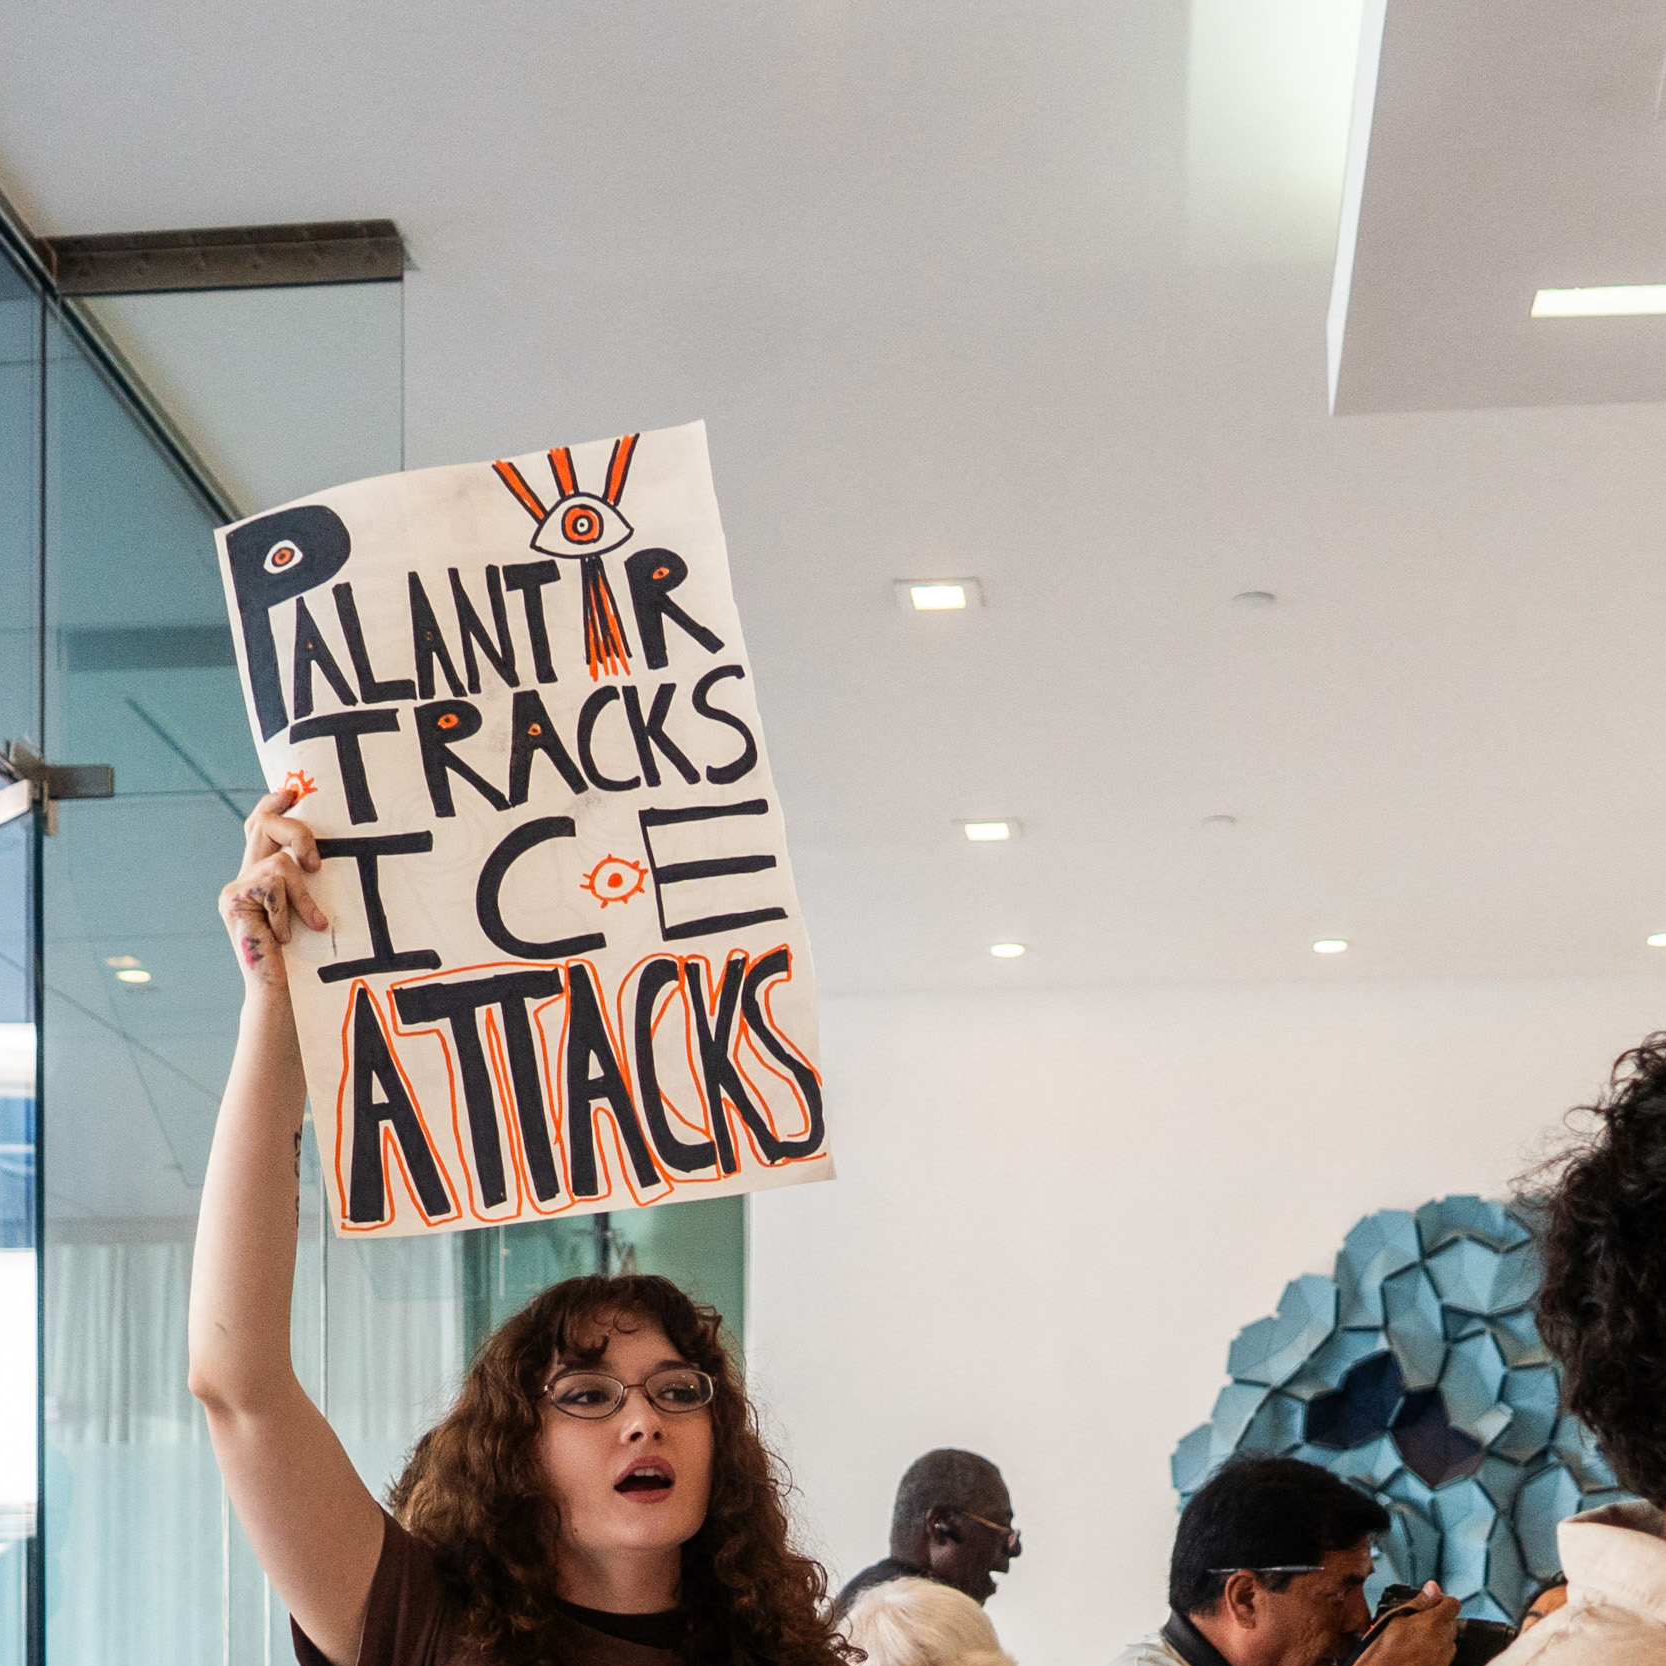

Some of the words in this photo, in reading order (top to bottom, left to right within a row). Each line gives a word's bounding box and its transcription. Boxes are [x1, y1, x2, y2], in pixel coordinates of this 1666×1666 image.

[225, 500, 724, 740] PALANTIR
[290, 664, 759, 825] TRACKS
[313, 798, 788, 984] ICE
[345, 946, 826, 1226] ATTACKS
